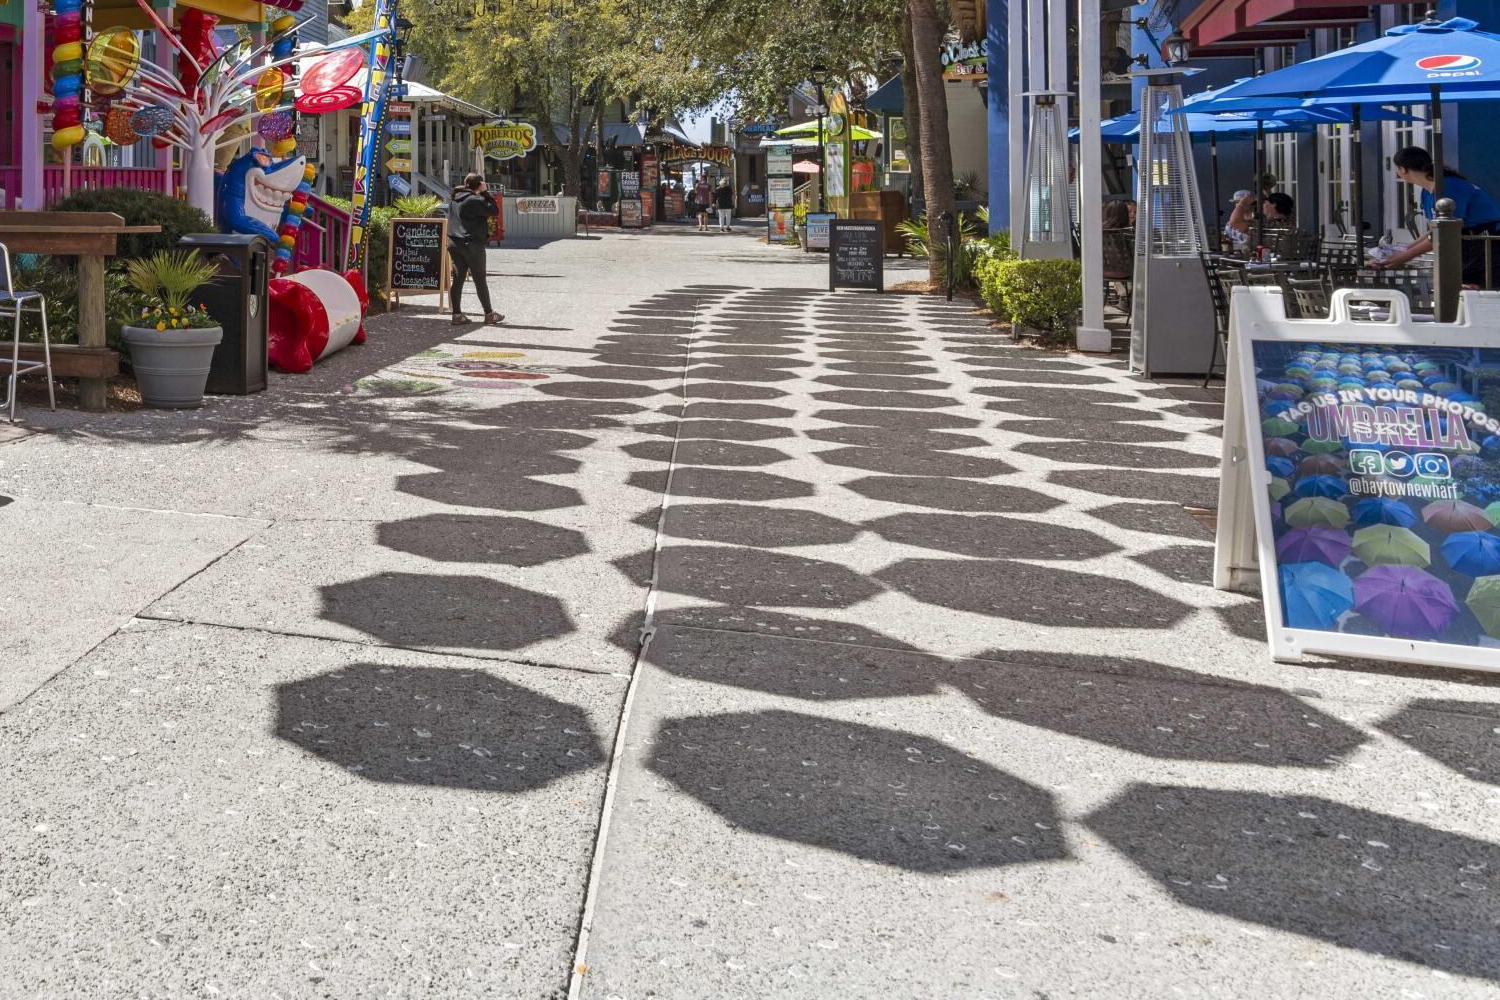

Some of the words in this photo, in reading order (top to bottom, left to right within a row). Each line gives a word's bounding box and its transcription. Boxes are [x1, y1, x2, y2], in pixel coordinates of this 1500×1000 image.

[474, 128, 532, 148] ROBERTO'S
[621, 171, 640, 180] FREE
[527, 200, 556, 208] PIZZA
[397, 224, 438, 237] Candied
[1277, 402, 1312, 423] TAG
[1313, 392, 1339, 408] US
[1337, 388, 1362, 404] IN
[1363, 387, 1418, 403] YOUR
[1306, 403, 1471, 449] UMBRELLA
[1352, 422, 1421, 436] SKY
[1350, 478, 1458, 500] @baytownewharf
